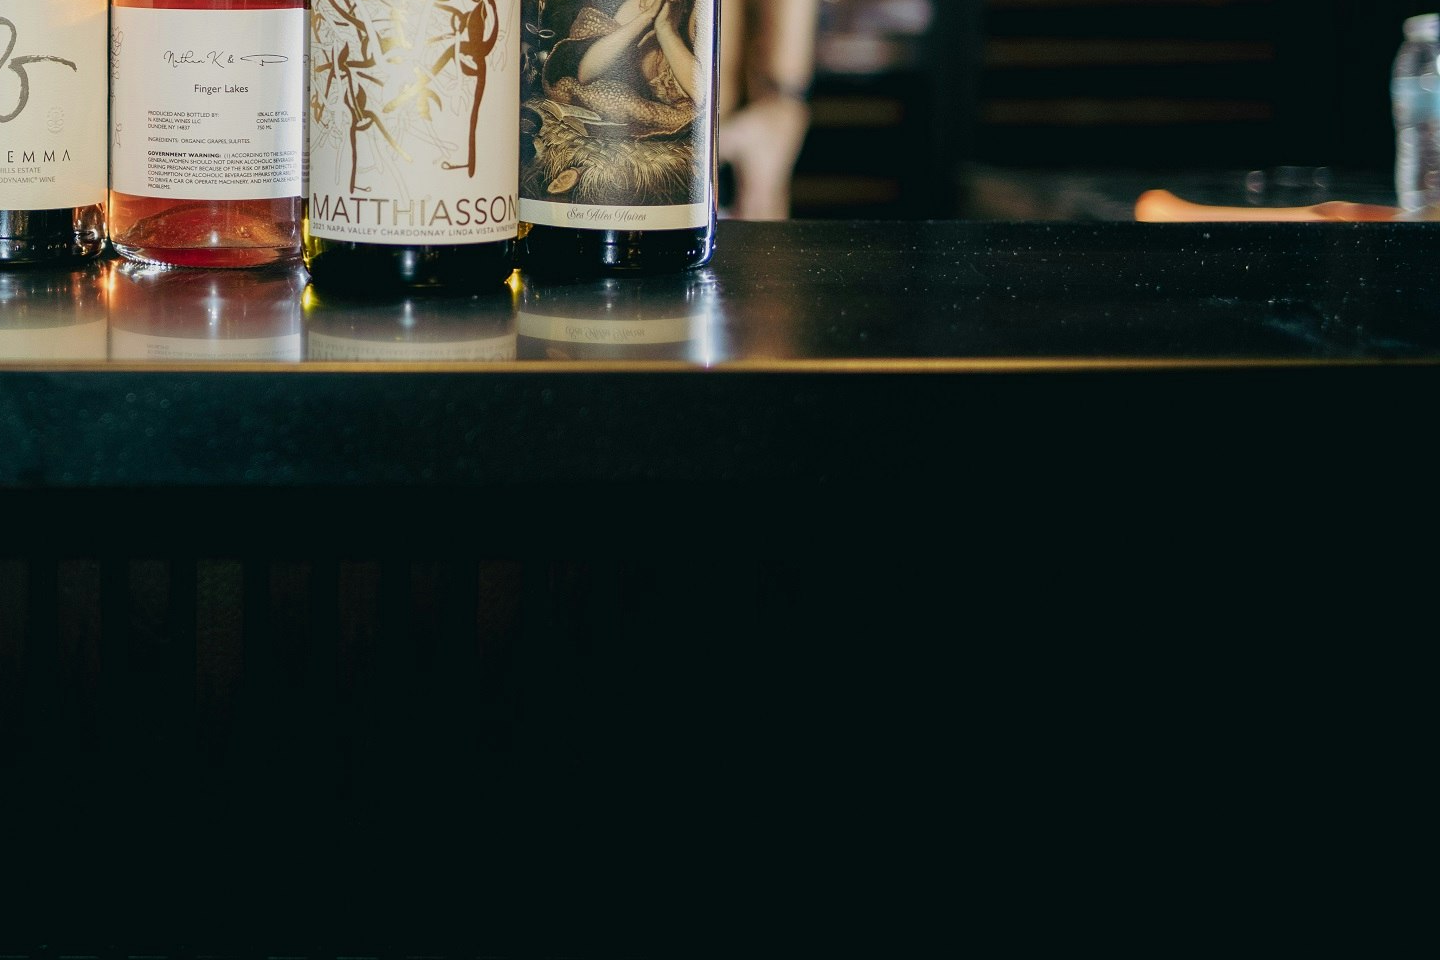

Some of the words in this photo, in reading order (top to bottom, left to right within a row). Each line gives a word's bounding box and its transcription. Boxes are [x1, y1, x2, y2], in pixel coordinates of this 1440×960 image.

[206, 50, 225, 69] K
[227, 54, 235, 64] &
[194, 84, 222, 96] Finger
[224, 84, 249, 94] Lakes
[17, 166, 42, 174] ESTATE
[39, 175, 56, 184] WINE
[313, 192, 517, 226] MATTHIASSON
[326, 224, 345, 233] NAPA
[347, 227, 377, 236] VALLEY
[380, 227, 446, 237] CHARDONNAY
[448, 228, 473, 237] LINDA
[475, 226, 494, 235] VISTA
